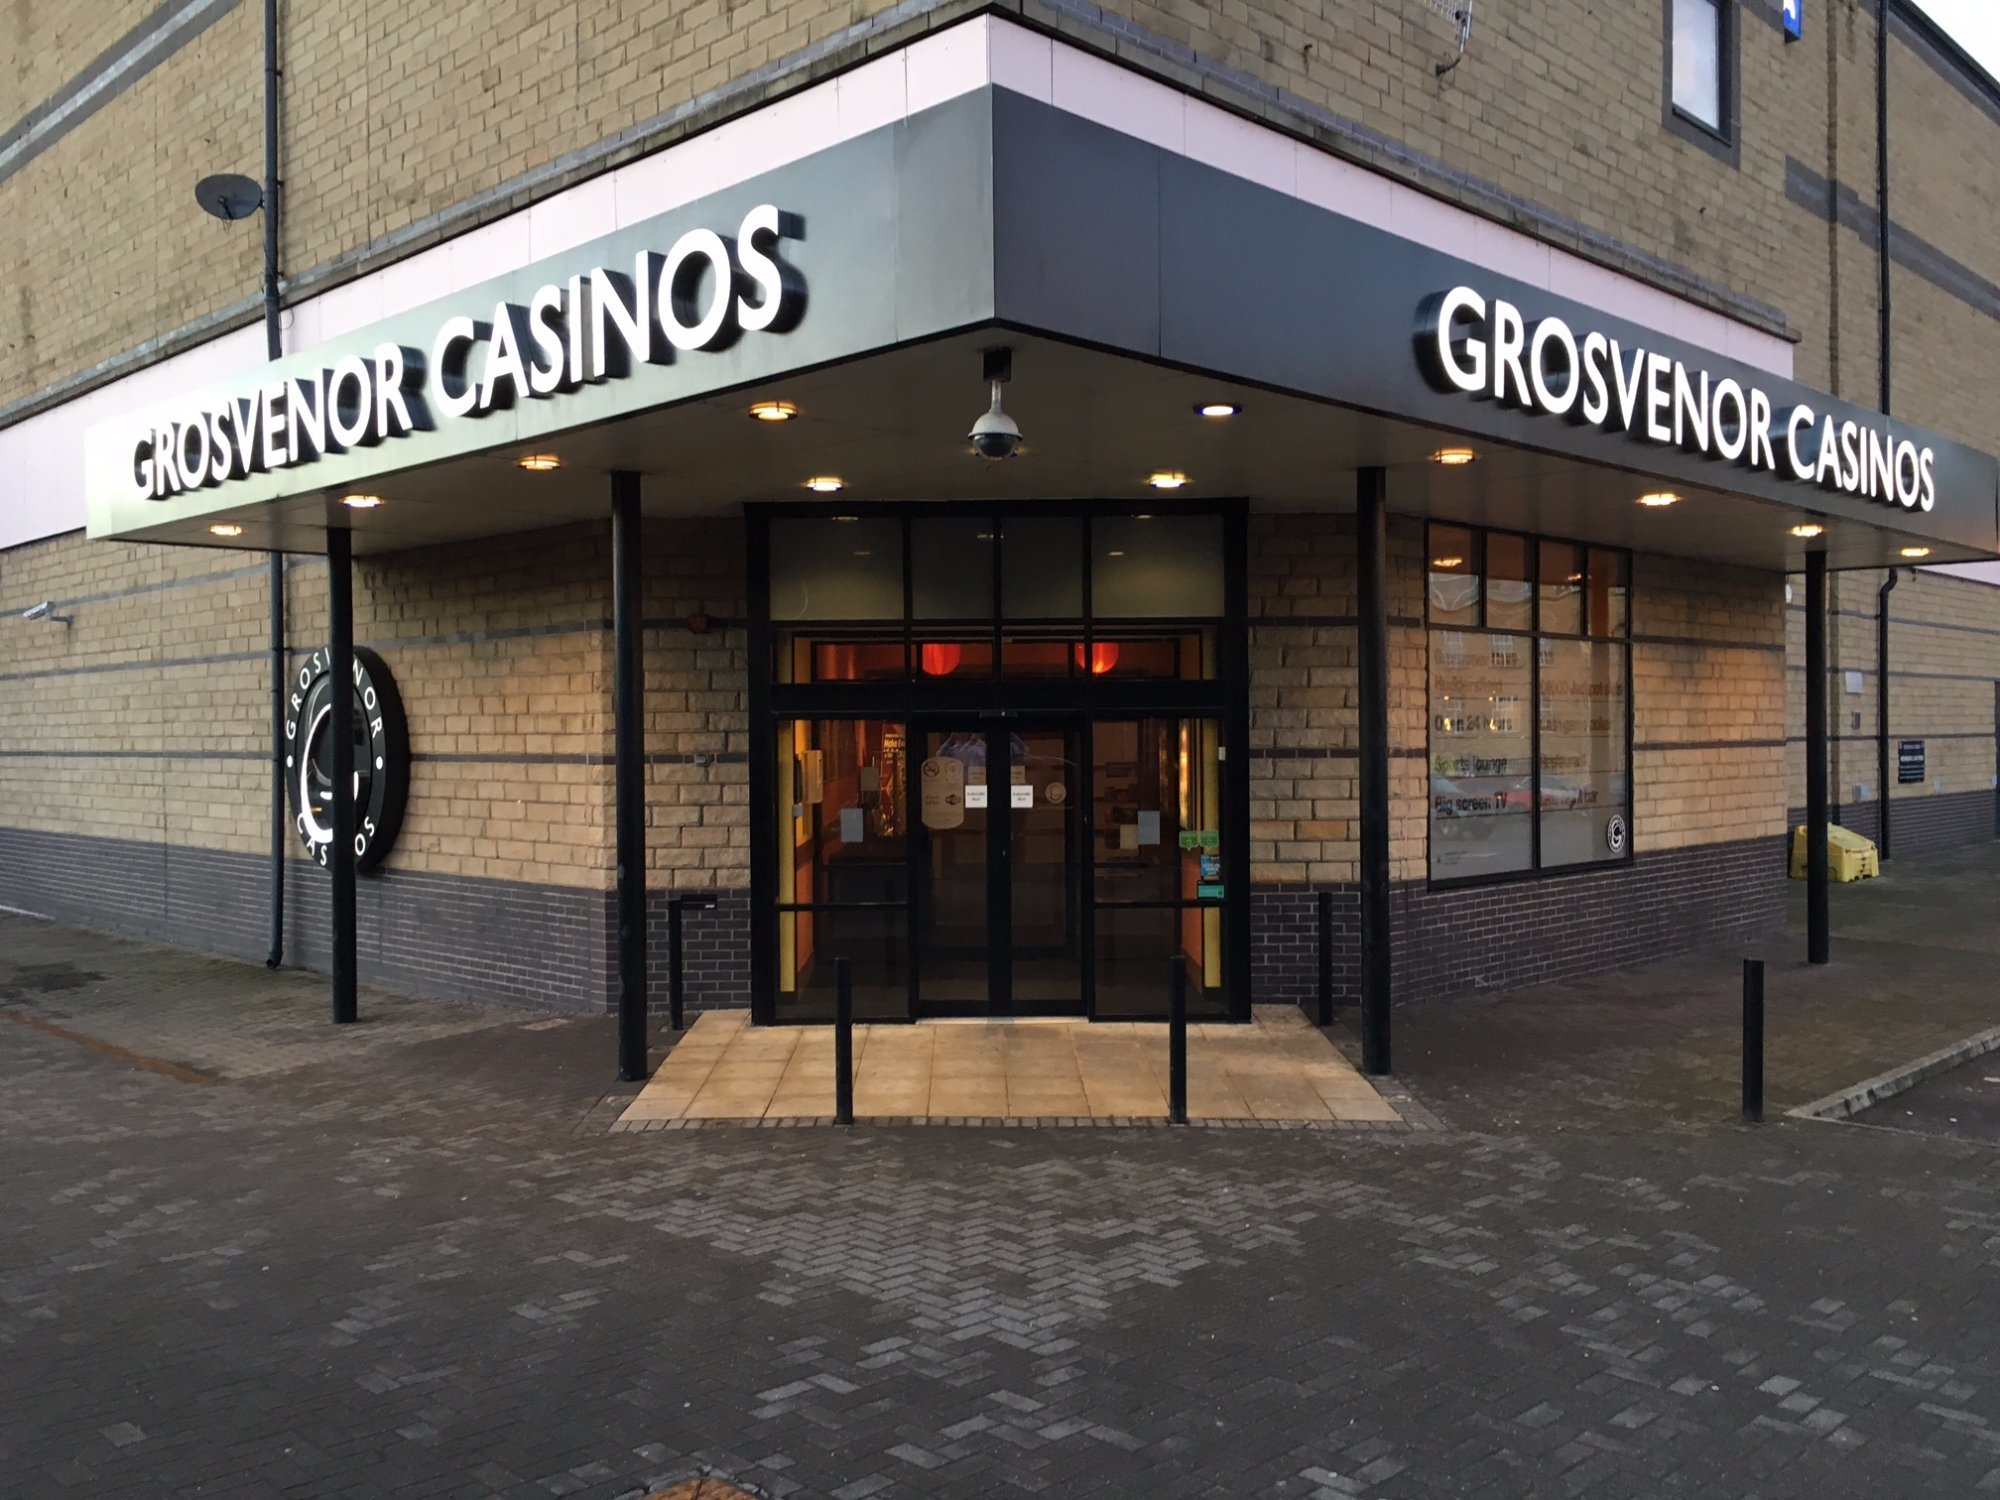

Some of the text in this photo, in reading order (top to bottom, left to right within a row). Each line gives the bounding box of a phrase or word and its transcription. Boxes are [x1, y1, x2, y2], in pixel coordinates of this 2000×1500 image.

[133, 203, 786, 499] GROSVENOR CASINOS
[1438, 286, 1934, 512] GROSVENOR CASINOS
[286, 647, 382, 740] GROSNOR
[1435, 714, 1464, 732] Oen
[1483, 714, 1512, 731] hurs
[1472, 755, 1507, 774] lounge
[1435, 791, 1508, 815] Big screen TV
[297, 812, 375, 866] CASOS
